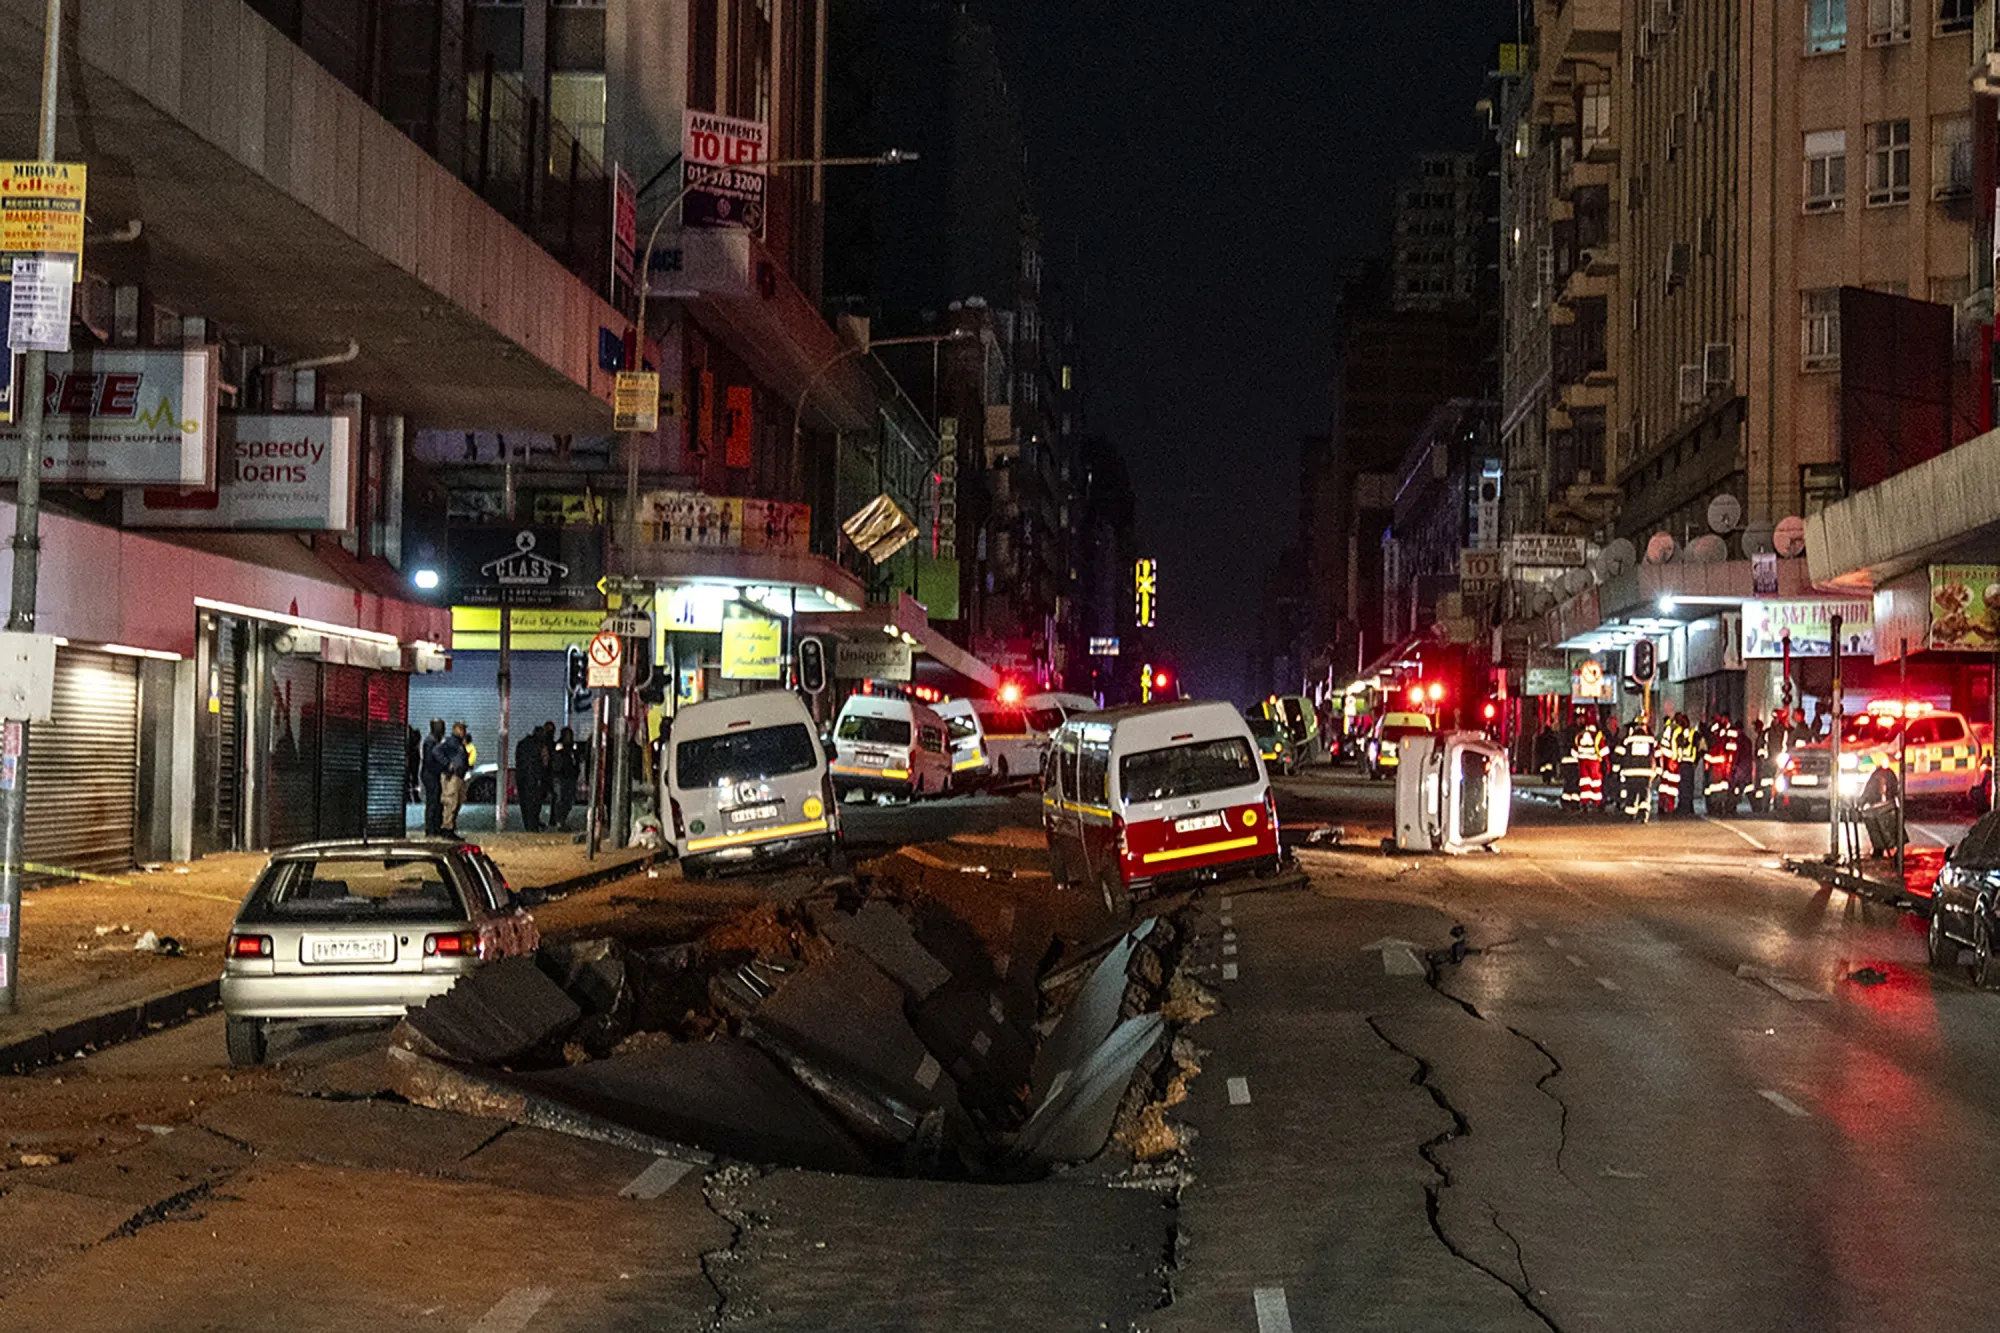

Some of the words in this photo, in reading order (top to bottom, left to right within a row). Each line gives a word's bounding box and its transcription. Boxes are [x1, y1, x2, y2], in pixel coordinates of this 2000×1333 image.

[691, 116, 763, 141] APARTMENTS
[691, 131, 720, 161] TO
[723, 137, 762, 166] LET
[734, 173, 762, 193] 3200
[5, 211, 80, 224] MANAGEMENT
[234, 436, 325, 465] speedy
[234, 459, 307, 484] loans
[496, 559, 553, 578] CLASS
[1467, 559, 1490, 577] TO
[1812, 602, 1869, 624] FASHION
